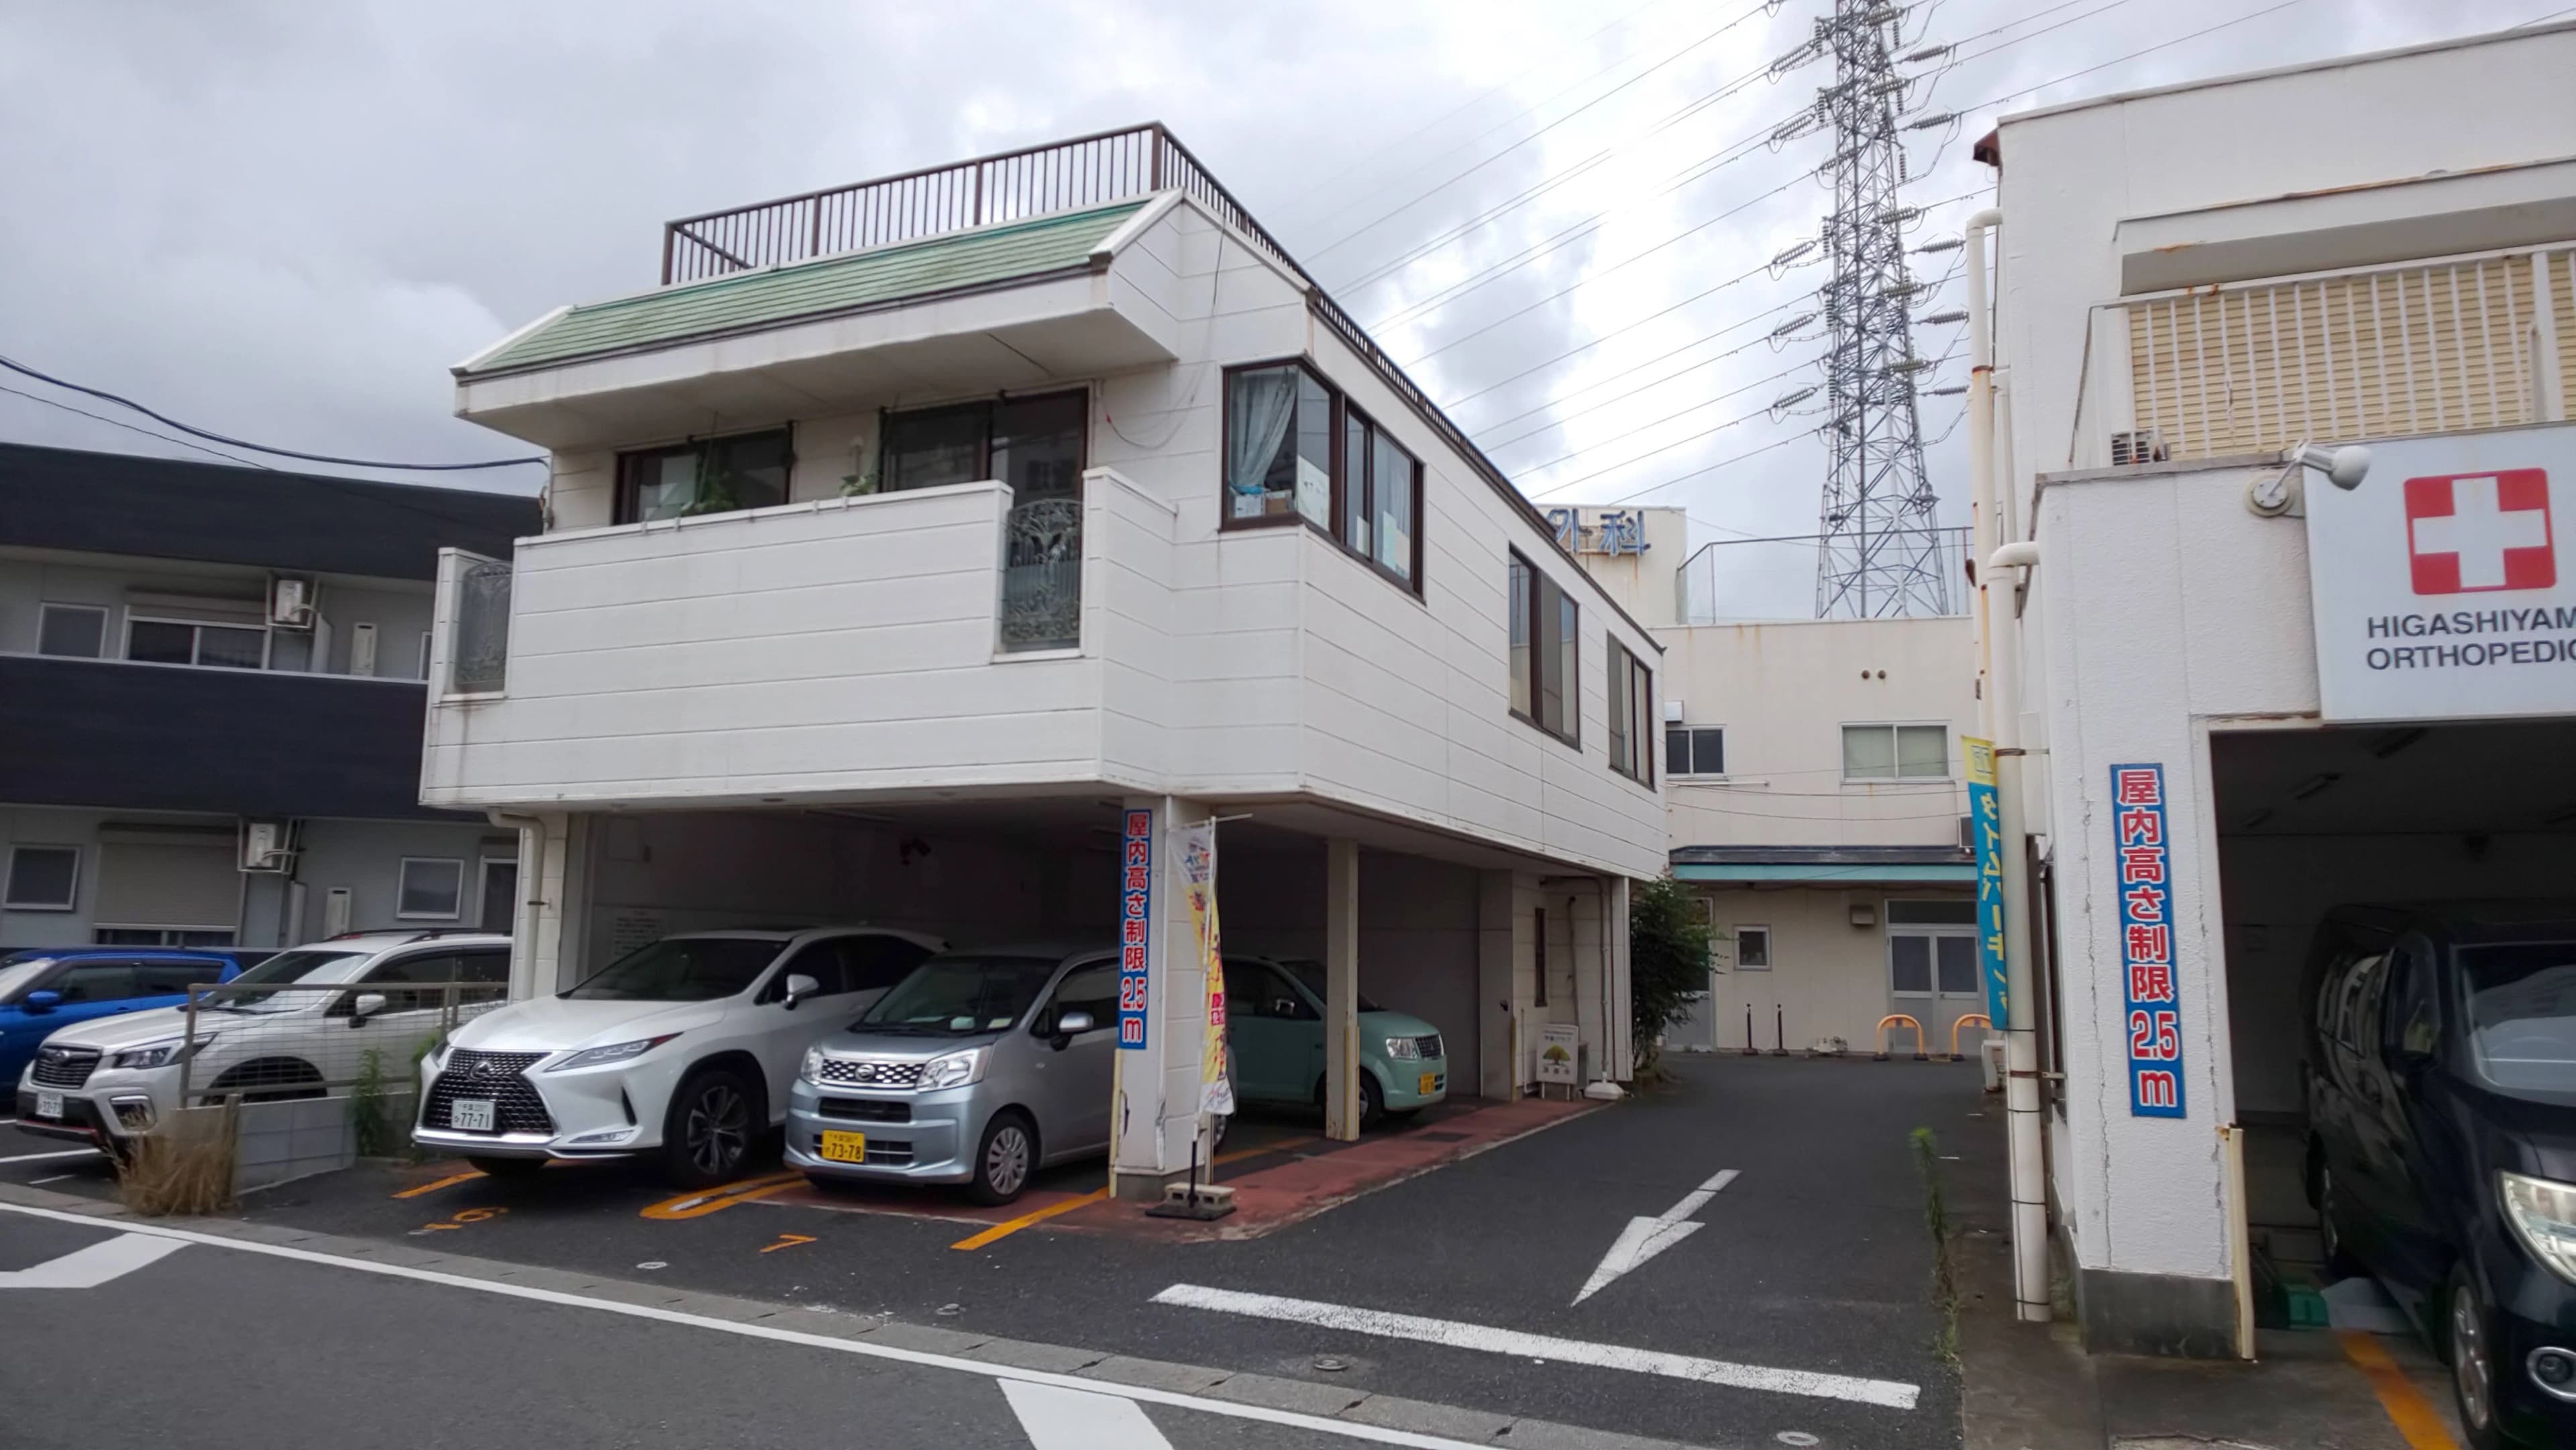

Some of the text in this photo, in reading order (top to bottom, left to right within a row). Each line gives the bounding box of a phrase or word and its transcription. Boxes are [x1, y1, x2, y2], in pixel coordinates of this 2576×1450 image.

[1546, 508, 1652, 556] 外科
[461, 1112, 489, 1128] 77-71
[832, 1143, 861, 1159] 73-78
